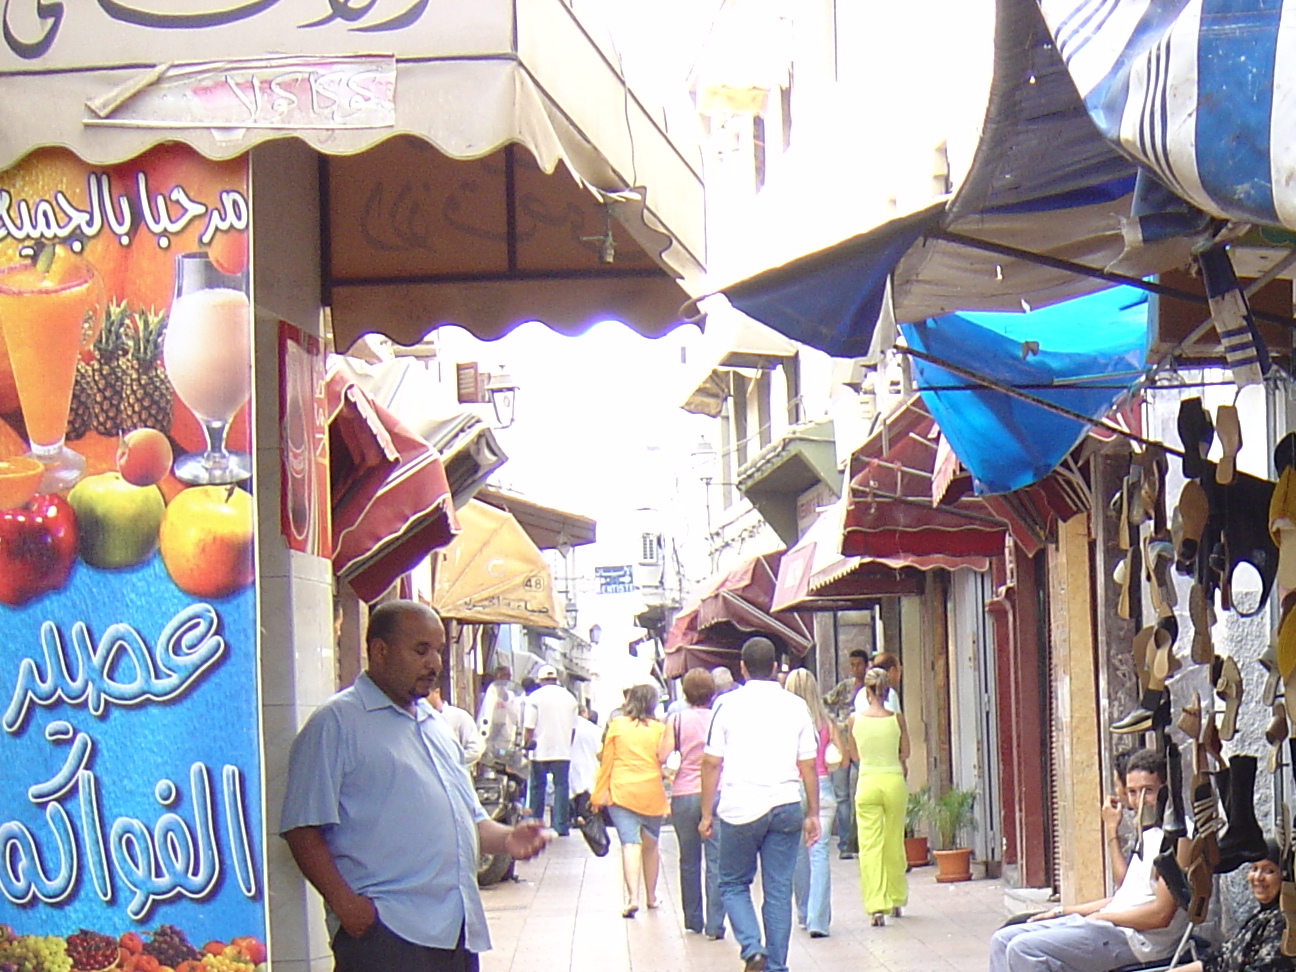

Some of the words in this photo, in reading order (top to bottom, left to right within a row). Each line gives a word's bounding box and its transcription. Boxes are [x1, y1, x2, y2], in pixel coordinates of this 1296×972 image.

[137, 172, 248, 247] مرحبا
[525, 578, 542, 590] 48
[2, 602, 224, 740] عصير
[0, 728, 256, 920] الفواكه
